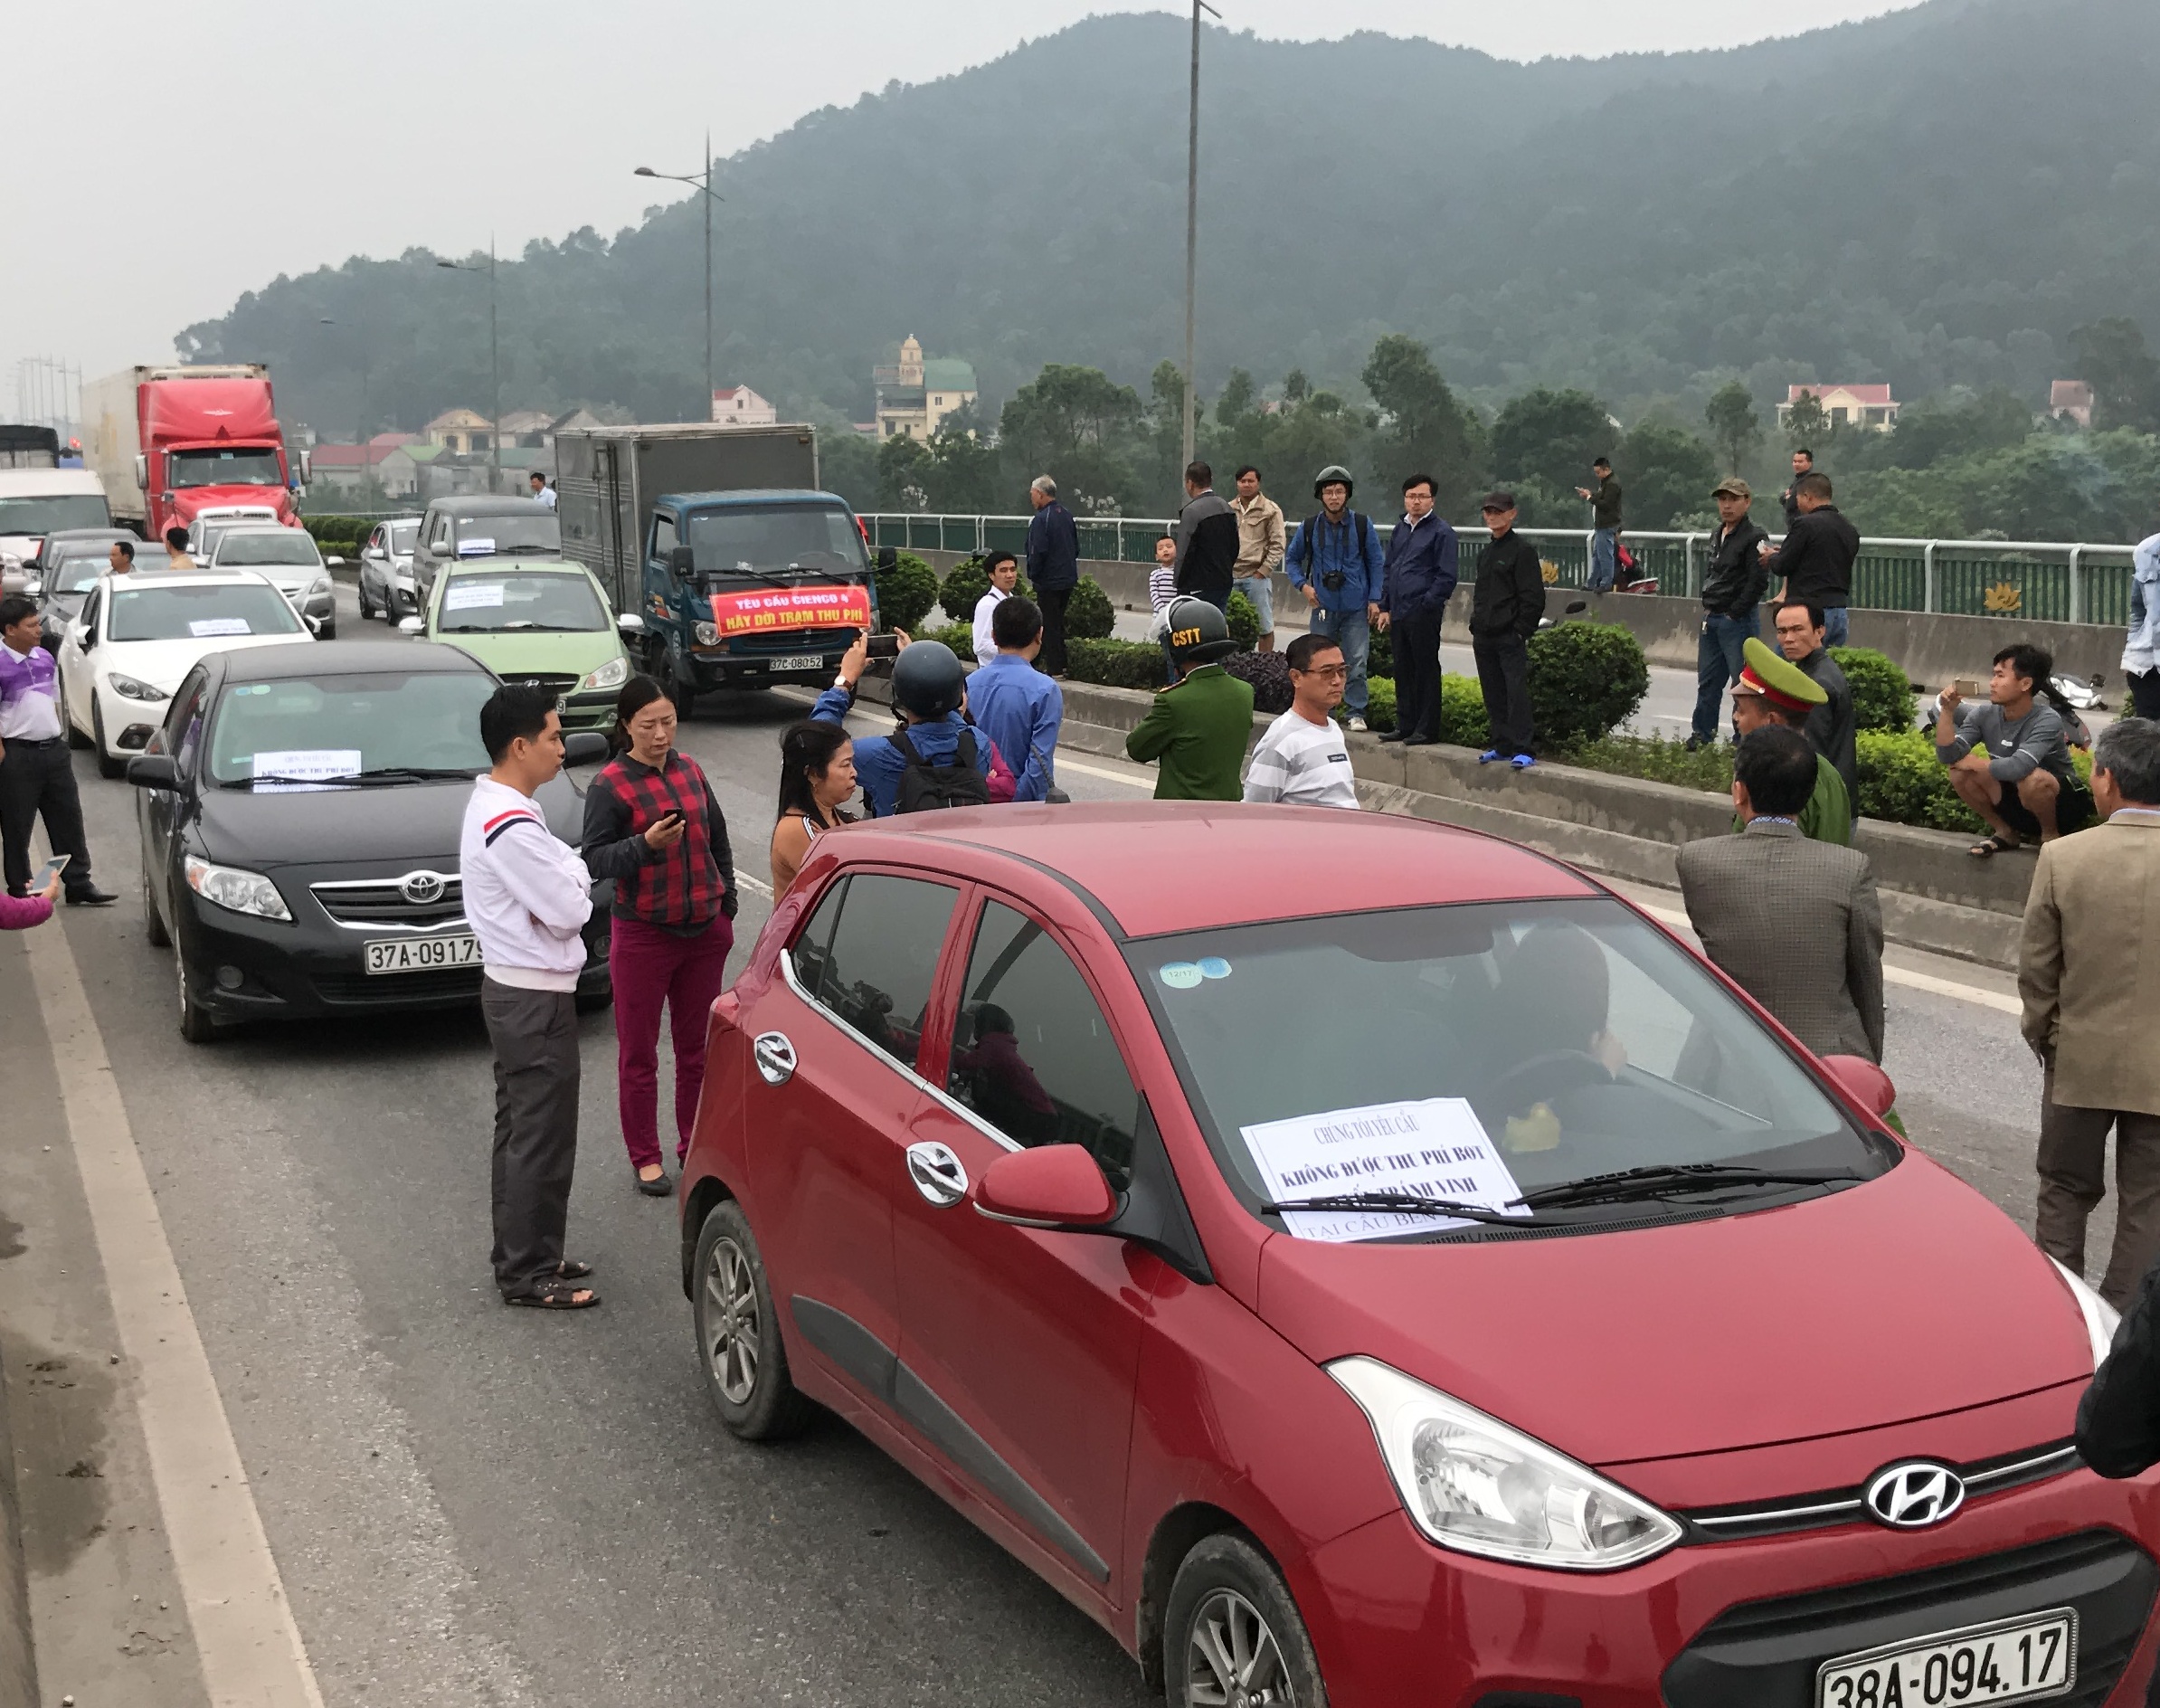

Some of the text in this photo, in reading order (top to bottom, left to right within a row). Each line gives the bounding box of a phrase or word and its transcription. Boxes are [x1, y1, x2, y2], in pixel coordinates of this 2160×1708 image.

[792, 593, 838, 606] CIENCO
[841, 593, 848, 603] 4
[725, 615, 751, 631] HÃY
[779, 609, 814, 626] TRẠM
[817, 609, 839, 622] THU
[843, 607, 862, 622] PHÍ
[1172, 627, 1200, 647] CSTT
[1313, 1121, 1354, 1144] CHÚNG
[1351, 1117, 1375, 1139] TÔI
[1371, 1115, 1396, 1136] YÊU
[1280, 1144, 1486, 1188] KHÔNG ĐƯỢC THU PHÍ BOT
[1435, 1176, 1479, 1195] VINH
[1830, 1627, 2062, 1708] 38A-094.17
